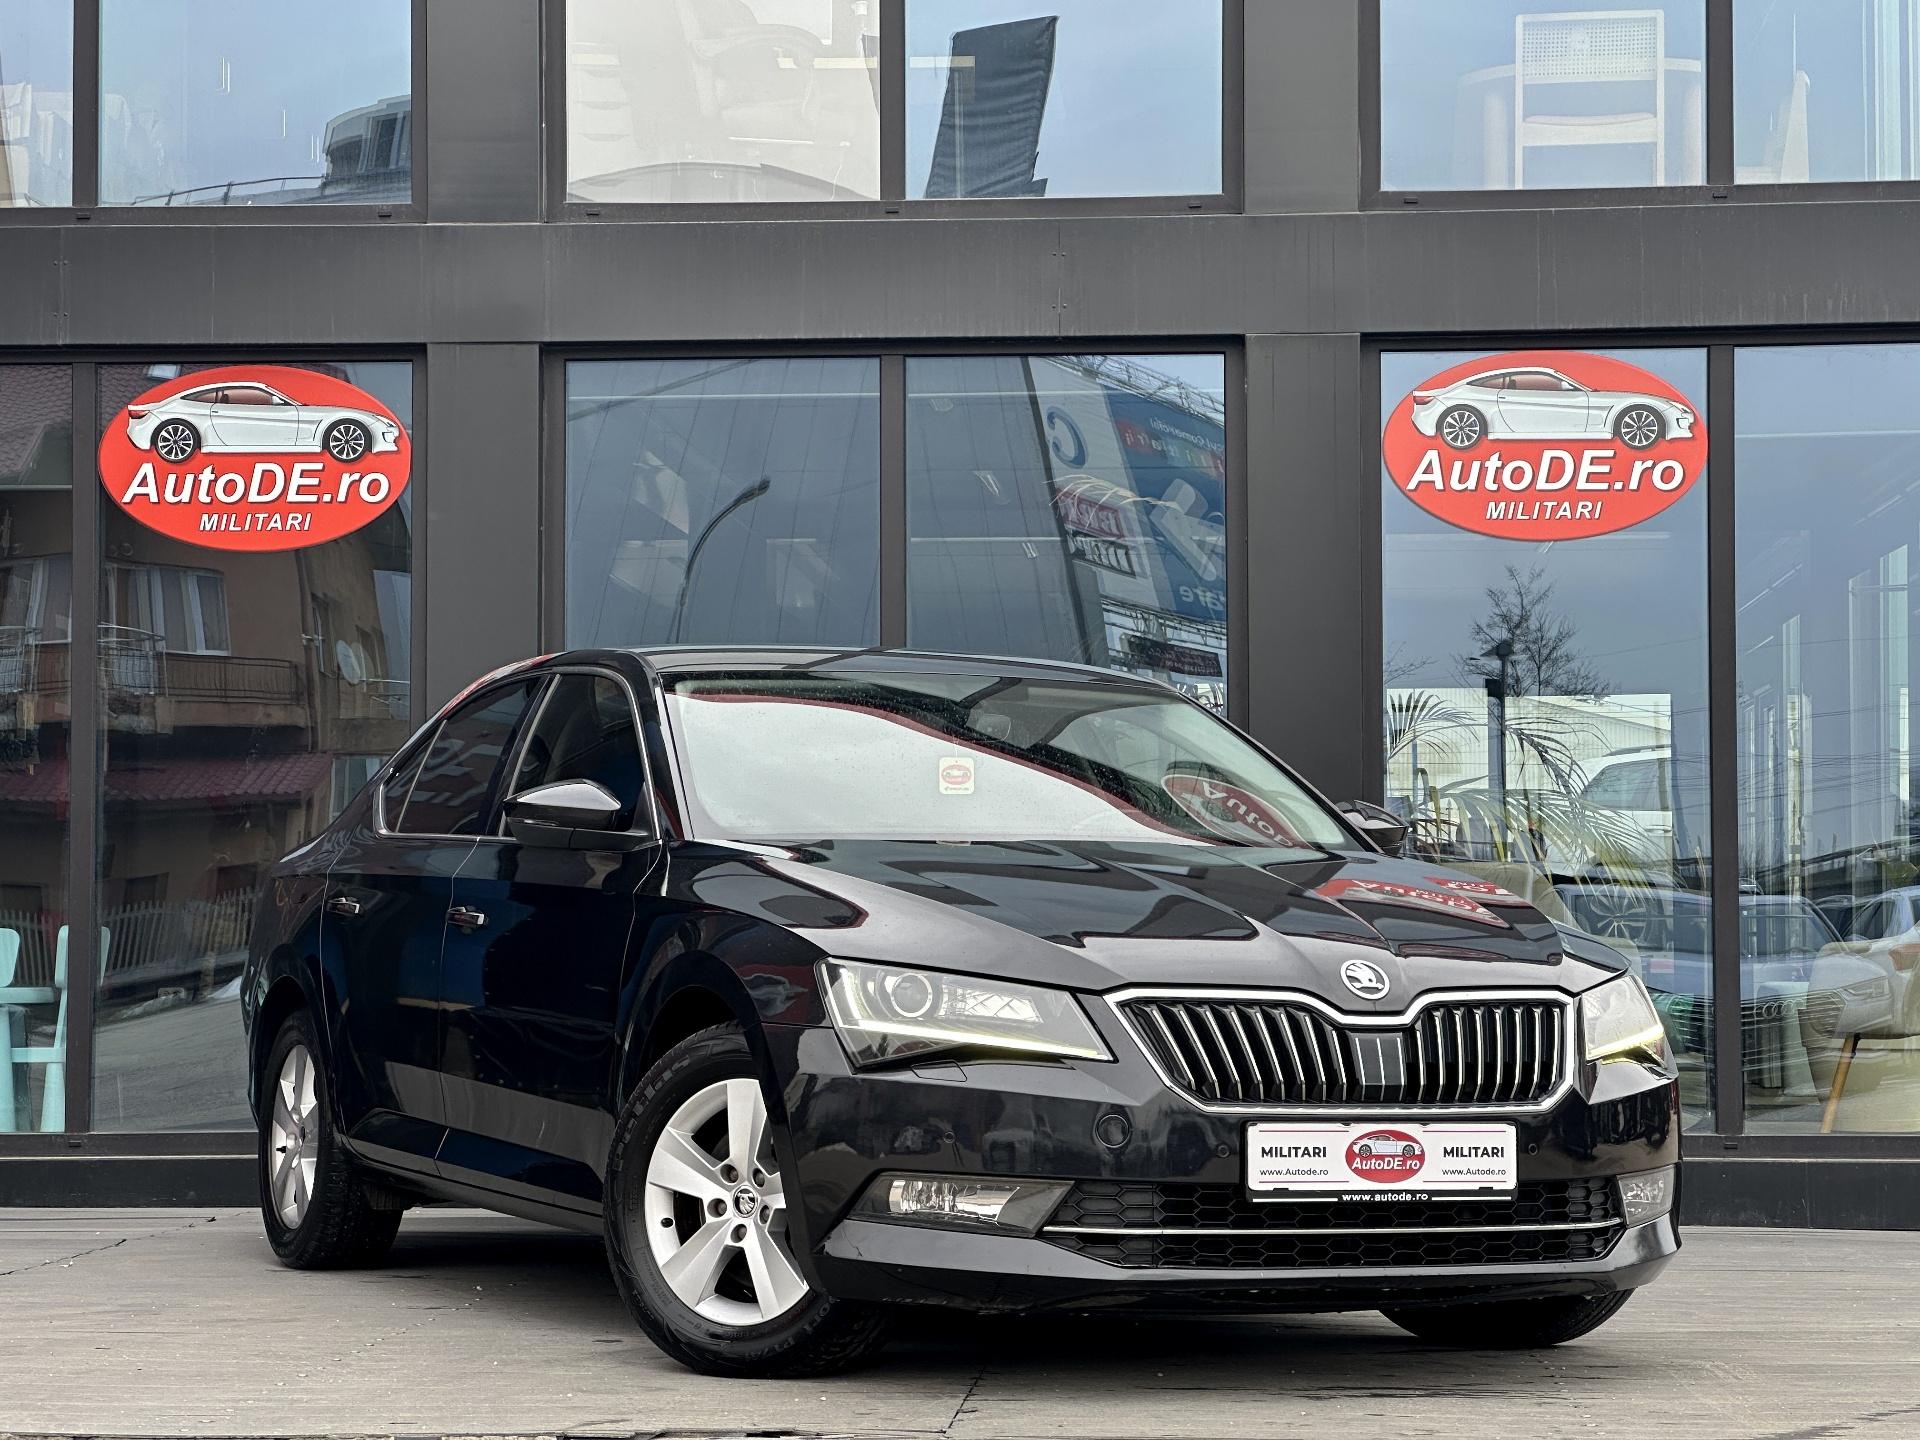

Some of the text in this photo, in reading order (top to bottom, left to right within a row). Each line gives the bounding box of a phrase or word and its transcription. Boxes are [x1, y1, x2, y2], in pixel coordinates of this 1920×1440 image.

[1406, 449, 1686, 491] AutoDE.ro
[121, 462, 390, 504] AutoDE.ro
[1484, 501, 1603, 520] MILITARI
[199, 512, 312, 532] MILITARI
[1261, 1146, 1327, 1158] MILITARI
[1443, 1146, 1505, 1158] MILITARI
[1351, 1157, 1421, 1172] AutoDE.ro
[1259, 1167, 1329, 1176] www.Autode.ro
[1441, 1167, 1507, 1176] www.Autode.ro
[1341, 1191, 1429, 1202] www.autode.ro
